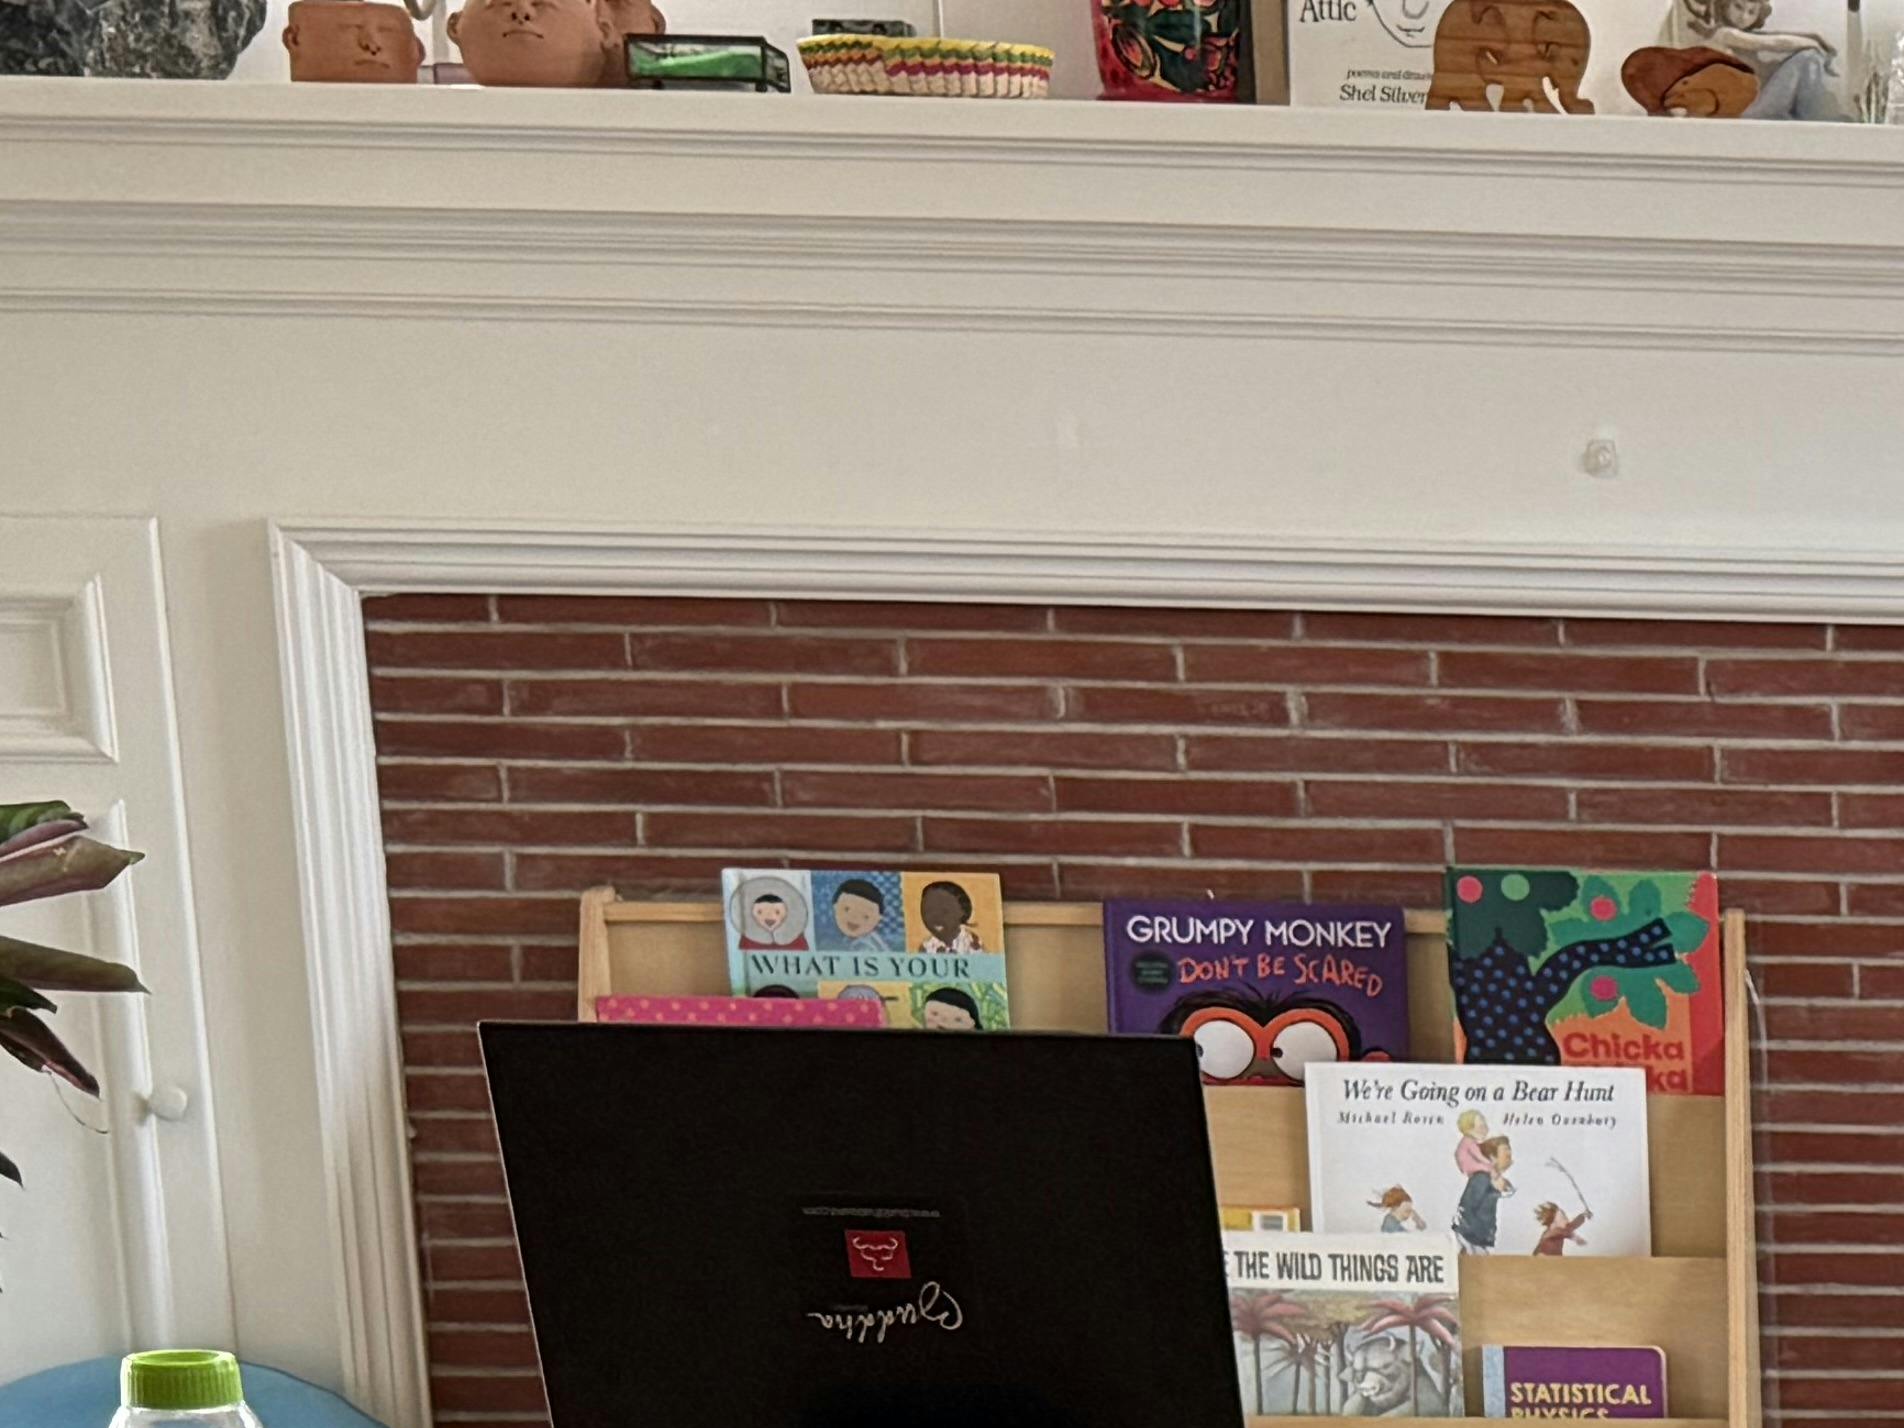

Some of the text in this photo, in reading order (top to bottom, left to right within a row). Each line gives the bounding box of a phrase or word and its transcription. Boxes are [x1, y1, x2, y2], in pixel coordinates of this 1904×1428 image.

[1299, 0, 1357, 23] Attic
[1339, 84, 1376, 102] Shel
[1126, 914, 1392, 948] GRUMPY MONKEY
[751, 953, 970, 979] WHAT IS YOUR
[1177, 954, 1249, 985] DON'T
[1257, 953, 1286, 979] BE
[1293, 953, 1384, 998] SCARED
[1562, 1031, 1685, 1061] Chicka
[1343, 1078, 1615, 1108] We're Going on a Bear Hunt
[1233, 1250, 1270, 1279] THE
[1276, 1251, 1323, 1281] WILD
[1327, 1253, 1399, 1283] THINGS
[1405, 1254, 1445, 1283] ARE
[805, 1281, 963, 1344] Buddha
[1510, 1381, 1653, 1405] STATISTICAL
